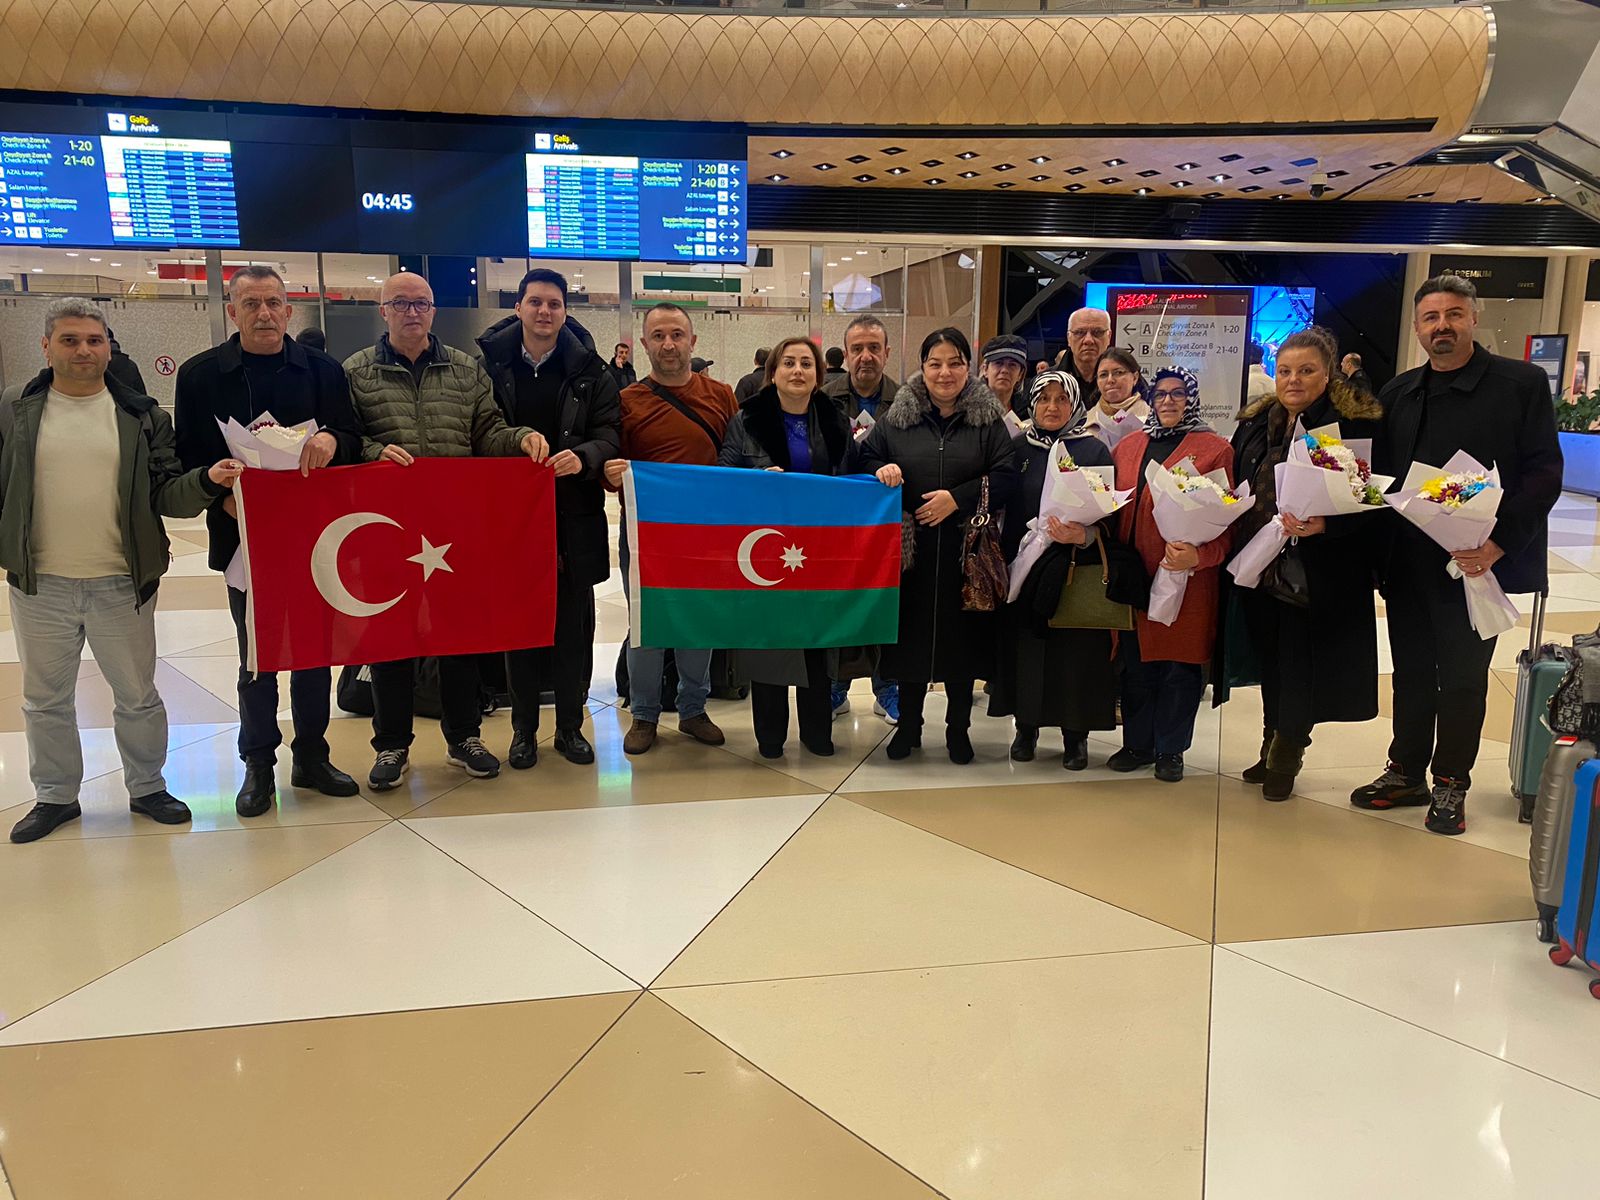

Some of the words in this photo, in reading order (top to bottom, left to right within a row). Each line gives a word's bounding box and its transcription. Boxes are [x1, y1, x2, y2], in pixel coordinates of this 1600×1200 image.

[130, 123, 159, 133] Arrivals
[68, 140, 93, 151] 1-20
[553, 142, 579, 150] Arrivals
[63, 155, 95, 166] 21-40
[21, 169, 44, 177] Lounge
[698, 164, 717, 174] 1-20
[720, 165, 726, 173] A
[690, 178, 717, 188] 21-40
[362, 192, 413, 210] 04:45
[1455, 270, 1492, 278] PREMIUM
[1143, 324, 1151, 334] A
[1223, 325, 1240, 333] 1-20
[1142, 345, 1150, 355] B
[1216, 346, 1239, 354] 21-40
[1531, 338, 1544, 355] P
